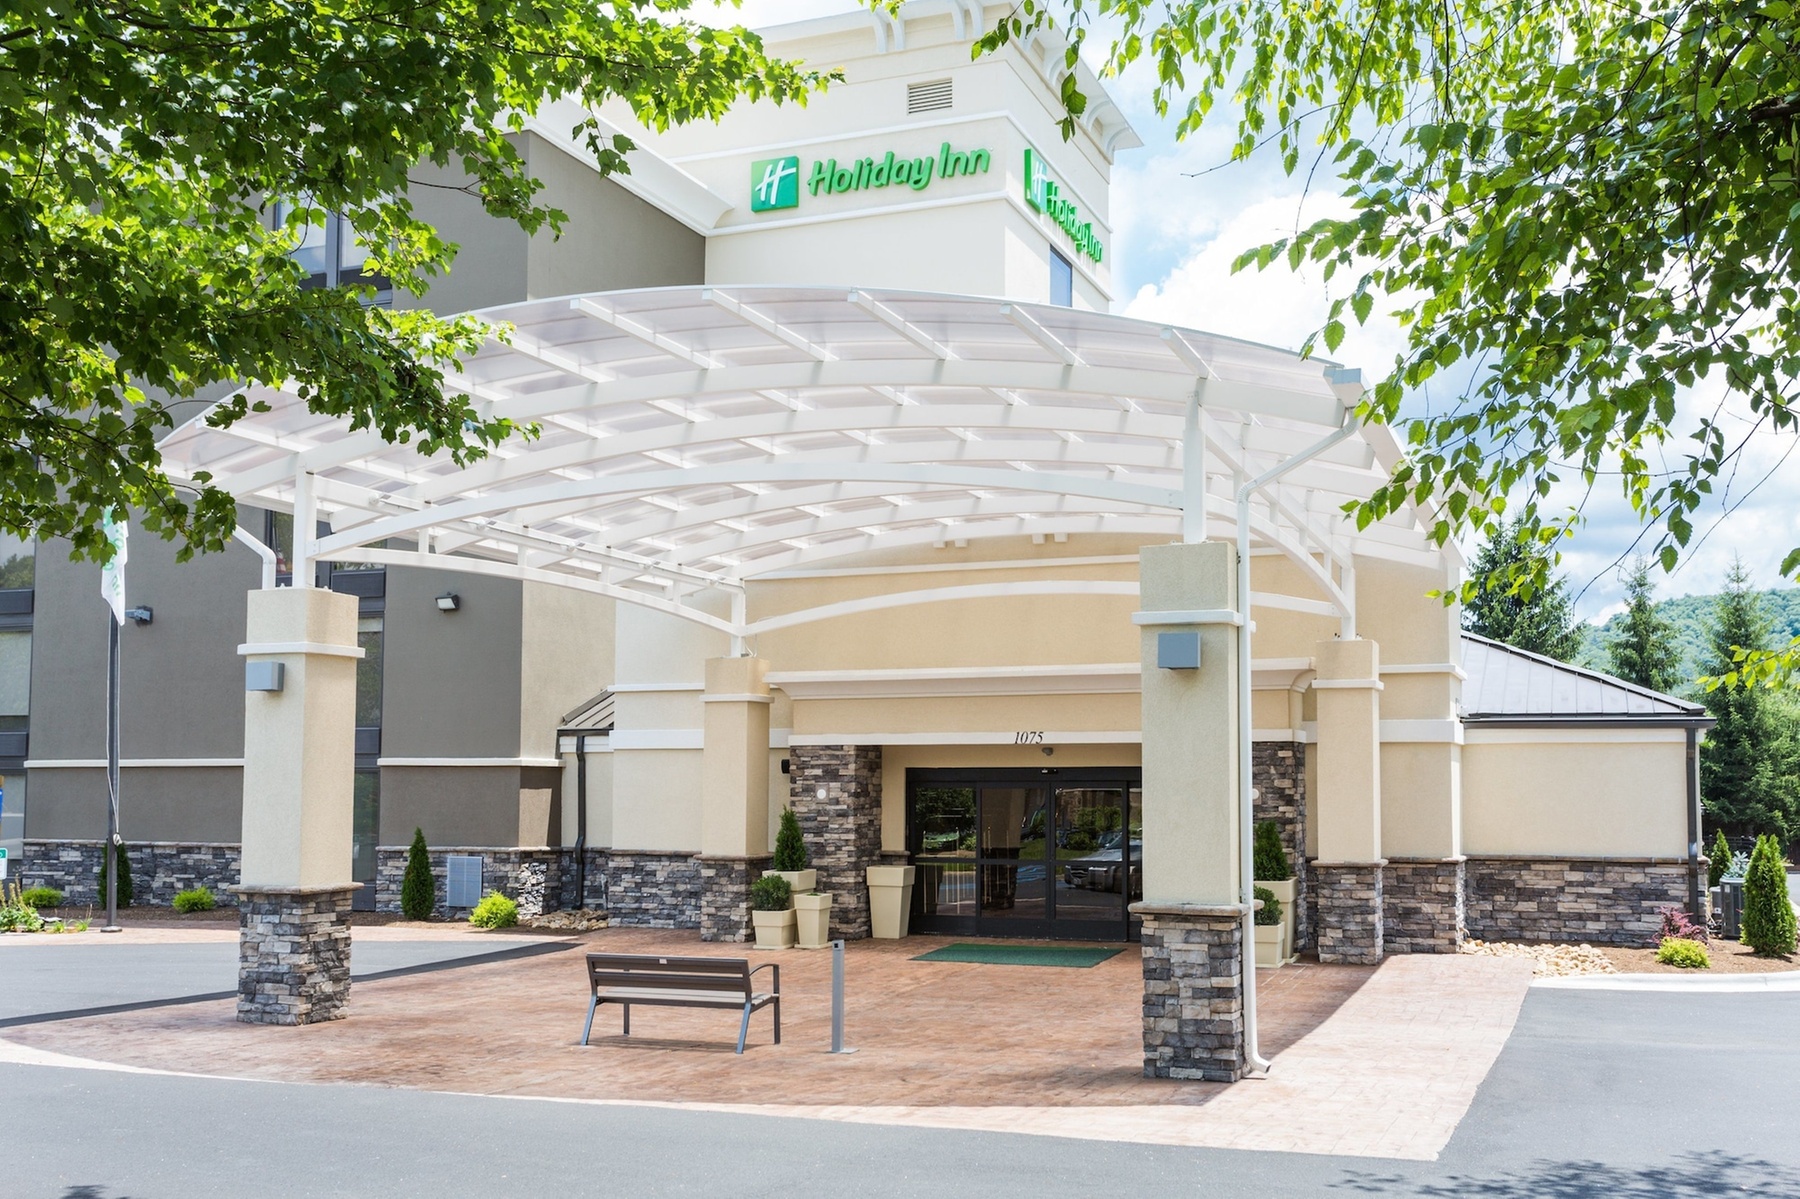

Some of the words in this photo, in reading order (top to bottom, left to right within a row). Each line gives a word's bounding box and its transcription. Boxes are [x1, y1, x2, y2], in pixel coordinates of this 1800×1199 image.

[807, 151, 934, 196] Holiday
[936, 142, 990, 179] Inn
[1047, 181, 1089, 253] Holiday
[1085, 223, 1103, 263] Inn
[1014, 730, 1044, 745] 1075
